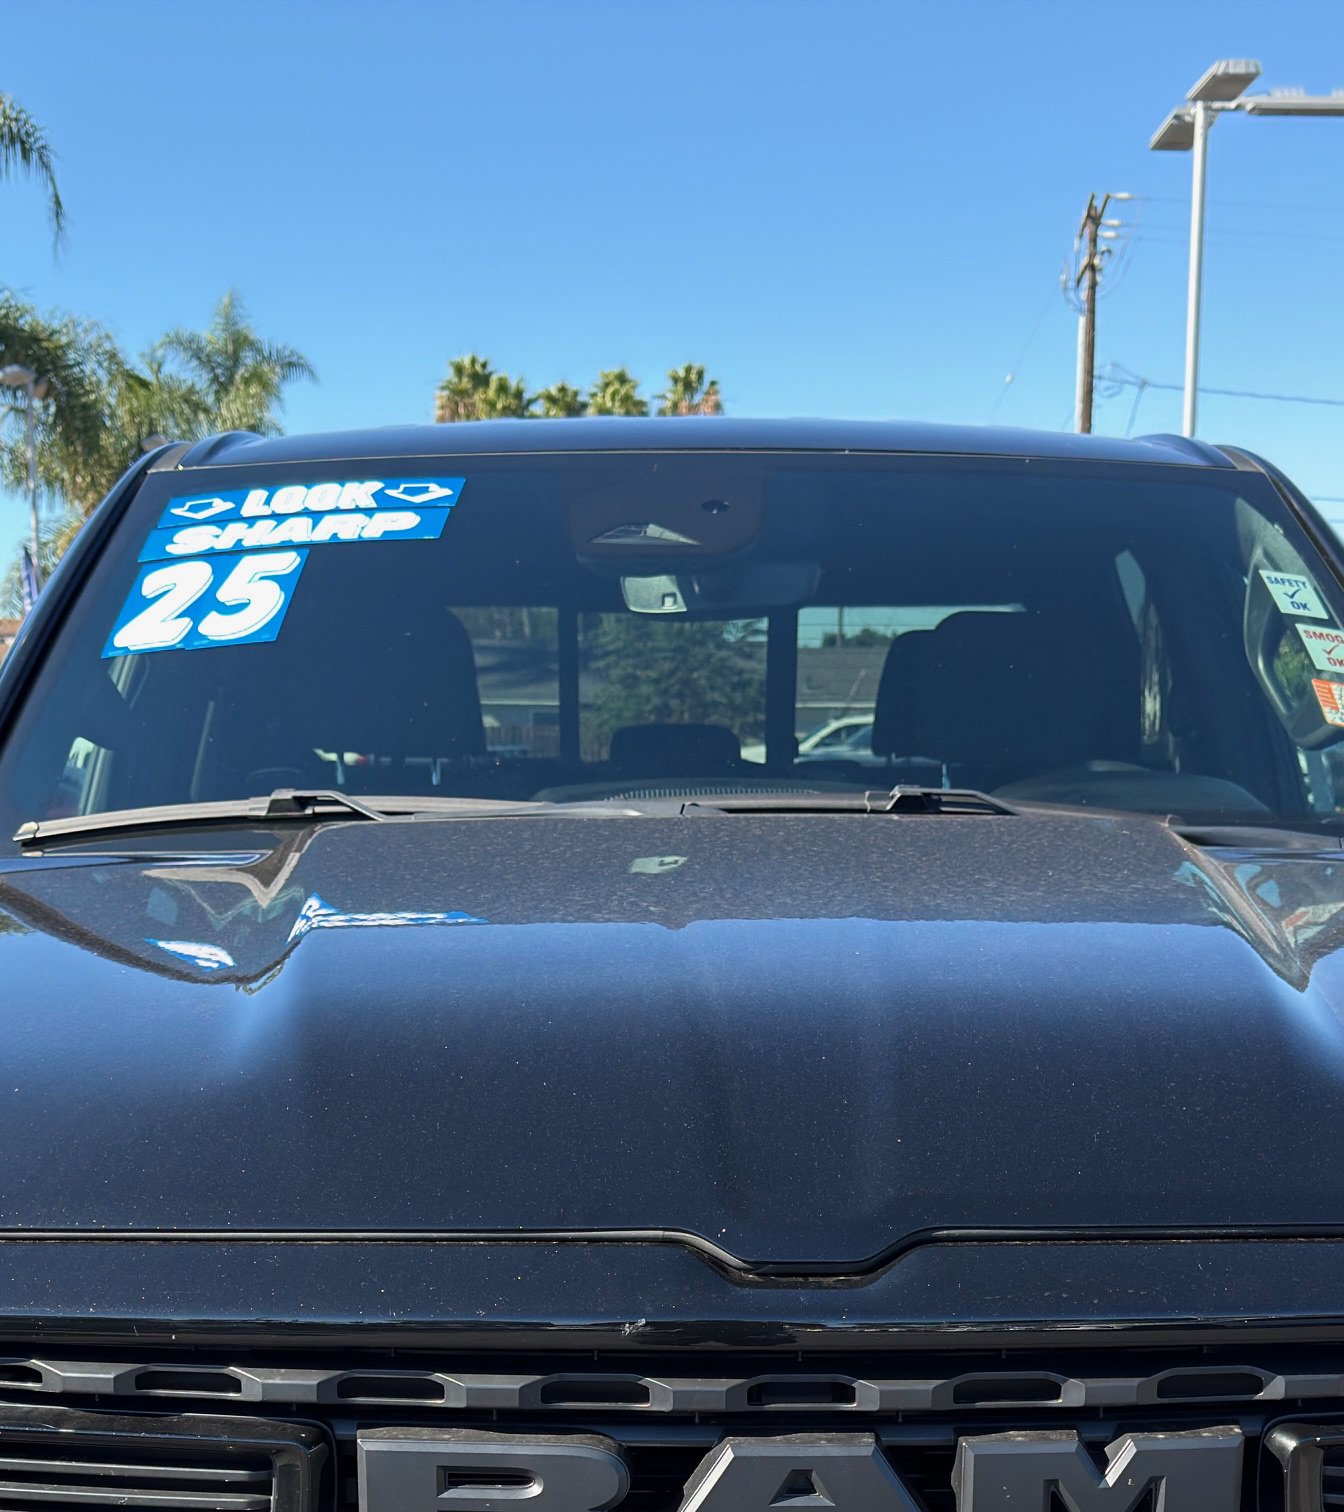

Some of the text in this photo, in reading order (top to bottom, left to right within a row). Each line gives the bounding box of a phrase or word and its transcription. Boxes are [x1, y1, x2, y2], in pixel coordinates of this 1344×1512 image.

[240, 481, 385, 518] LOOK
[165, 511, 421, 555] SHARP
[1266, 575, 1308, 589] SAFETY
[113, 551, 301, 651] 25
[1290, 601, 1311, 612] OK
[1303, 630, 1344, 645] SMOG
